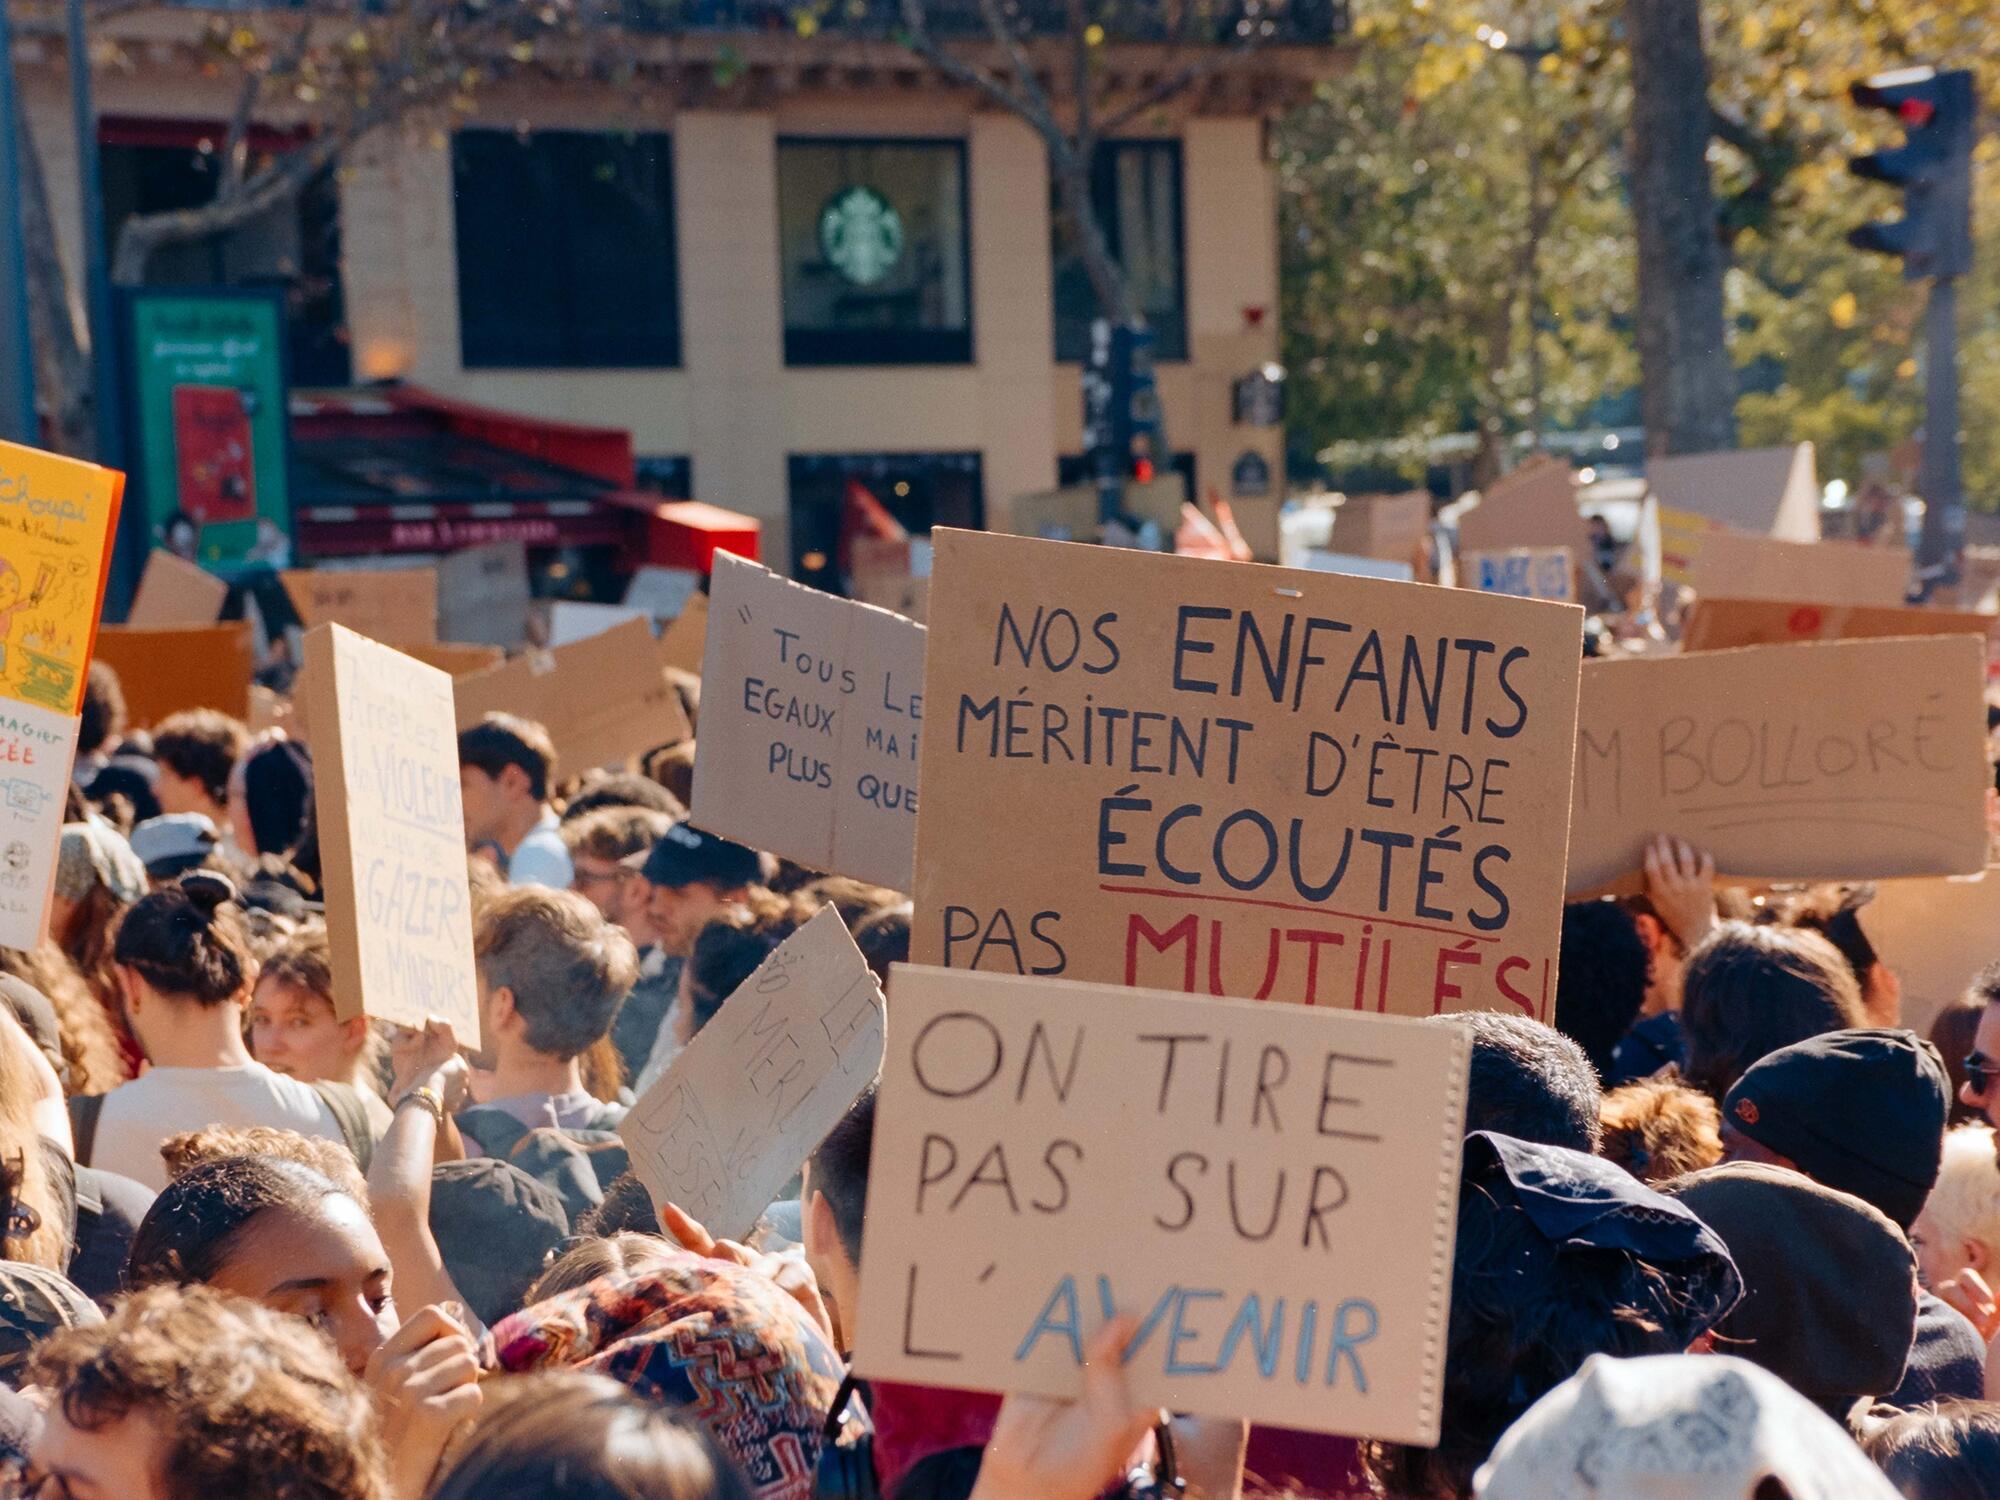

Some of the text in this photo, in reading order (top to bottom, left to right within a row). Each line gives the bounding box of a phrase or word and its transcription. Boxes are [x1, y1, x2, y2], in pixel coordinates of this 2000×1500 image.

[744, 677, 835, 737] EGAUX
[994, 603, 1531, 738] NOS ENFANTS
[0, 737, 35, 765] ÉE
[769, 742, 919, 814] PLUS QUE
[1306, 731, 1510, 825] D'ÊTRE
[1658, 692, 1955, 797] BOLLORÉ
[1098, 785, 1512, 931] ÉCOUTÉS
[368, 859, 463, 950] GAZER
[942, 907, 1067, 977] PAS
[386, 938, 473, 1019] MINEURS
[912, 1011, 1395, 1144] ON TIRE
[914, 1134, 1350, 1252] PAS SUR
